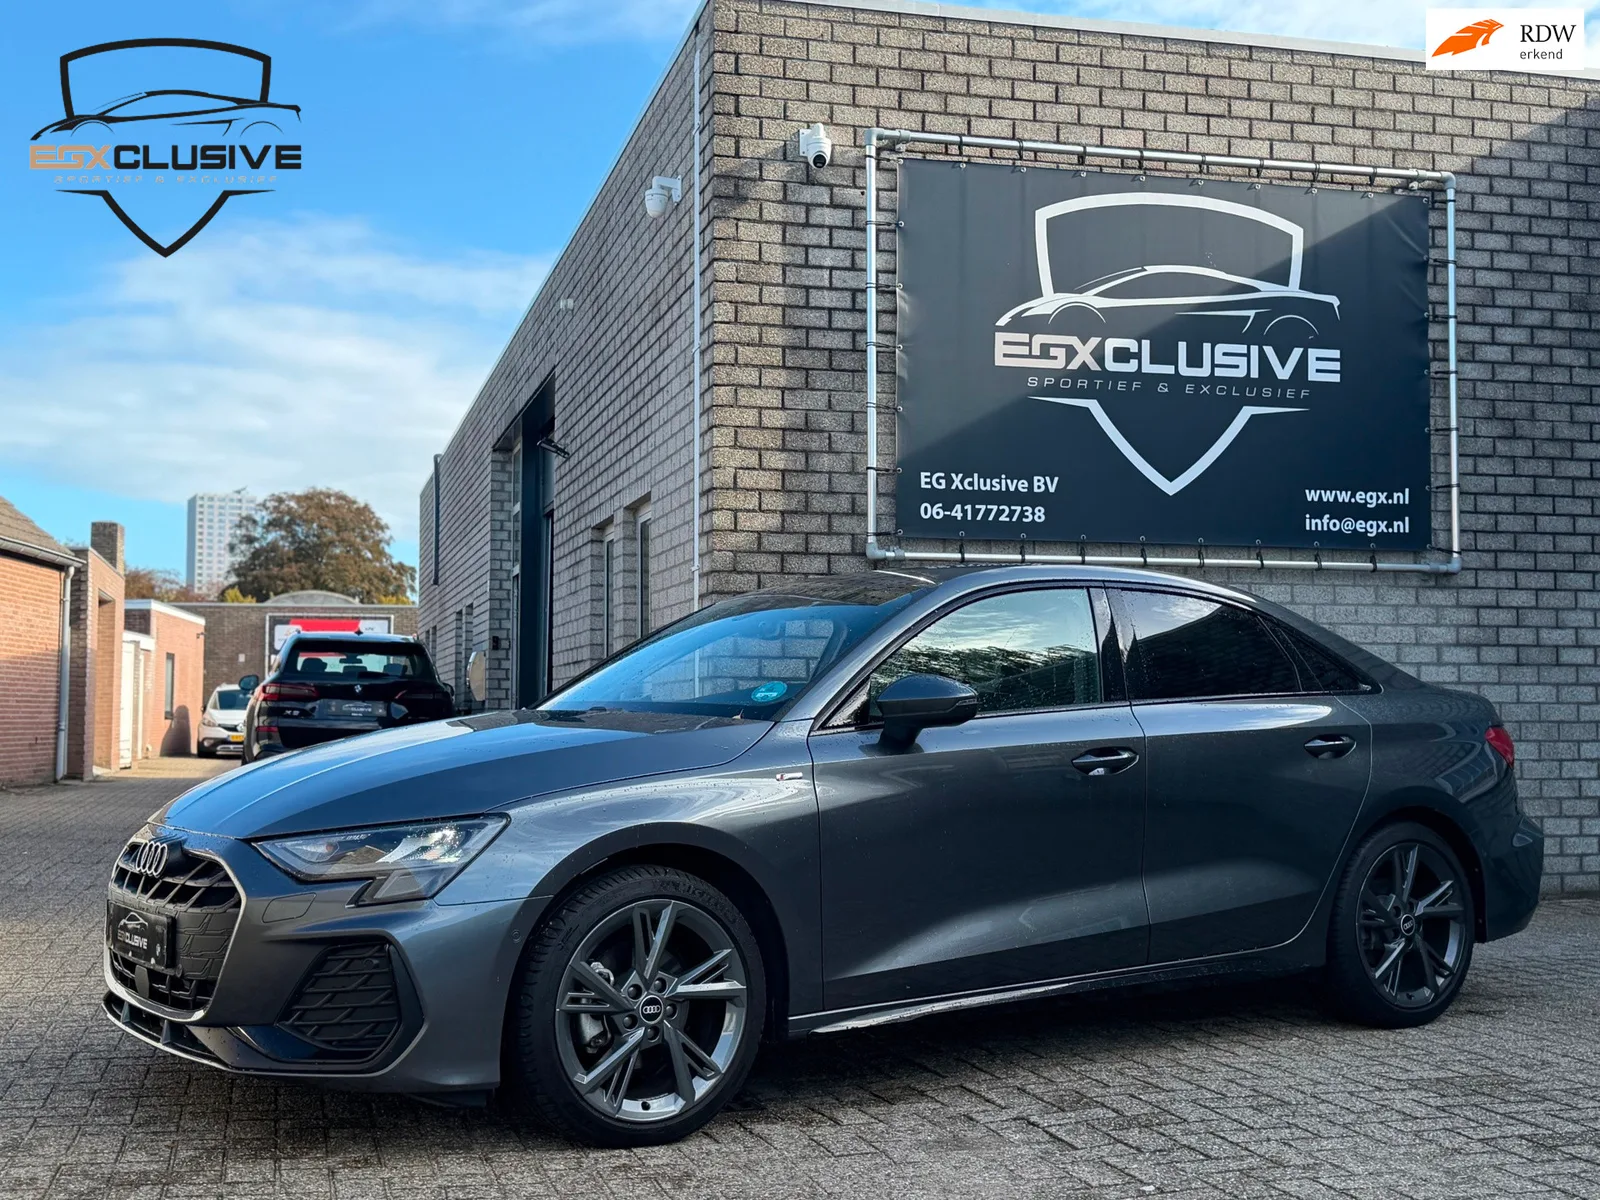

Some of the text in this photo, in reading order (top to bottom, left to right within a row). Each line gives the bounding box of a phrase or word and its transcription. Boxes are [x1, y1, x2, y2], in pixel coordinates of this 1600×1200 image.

[994, 331, 1342, 383] EGXCLUSIVE
[1027, 376, 1311, 400] SPORTIEF & EXCLUSIEF
[920, 472, 1059, 493] EG Xclusive BV
[1305, 488, 1410, 508] www.egx.nl
[920, 502, 1046, 523] 06-41772738
[1305, 514, 1410, 537] info@egx.nl
